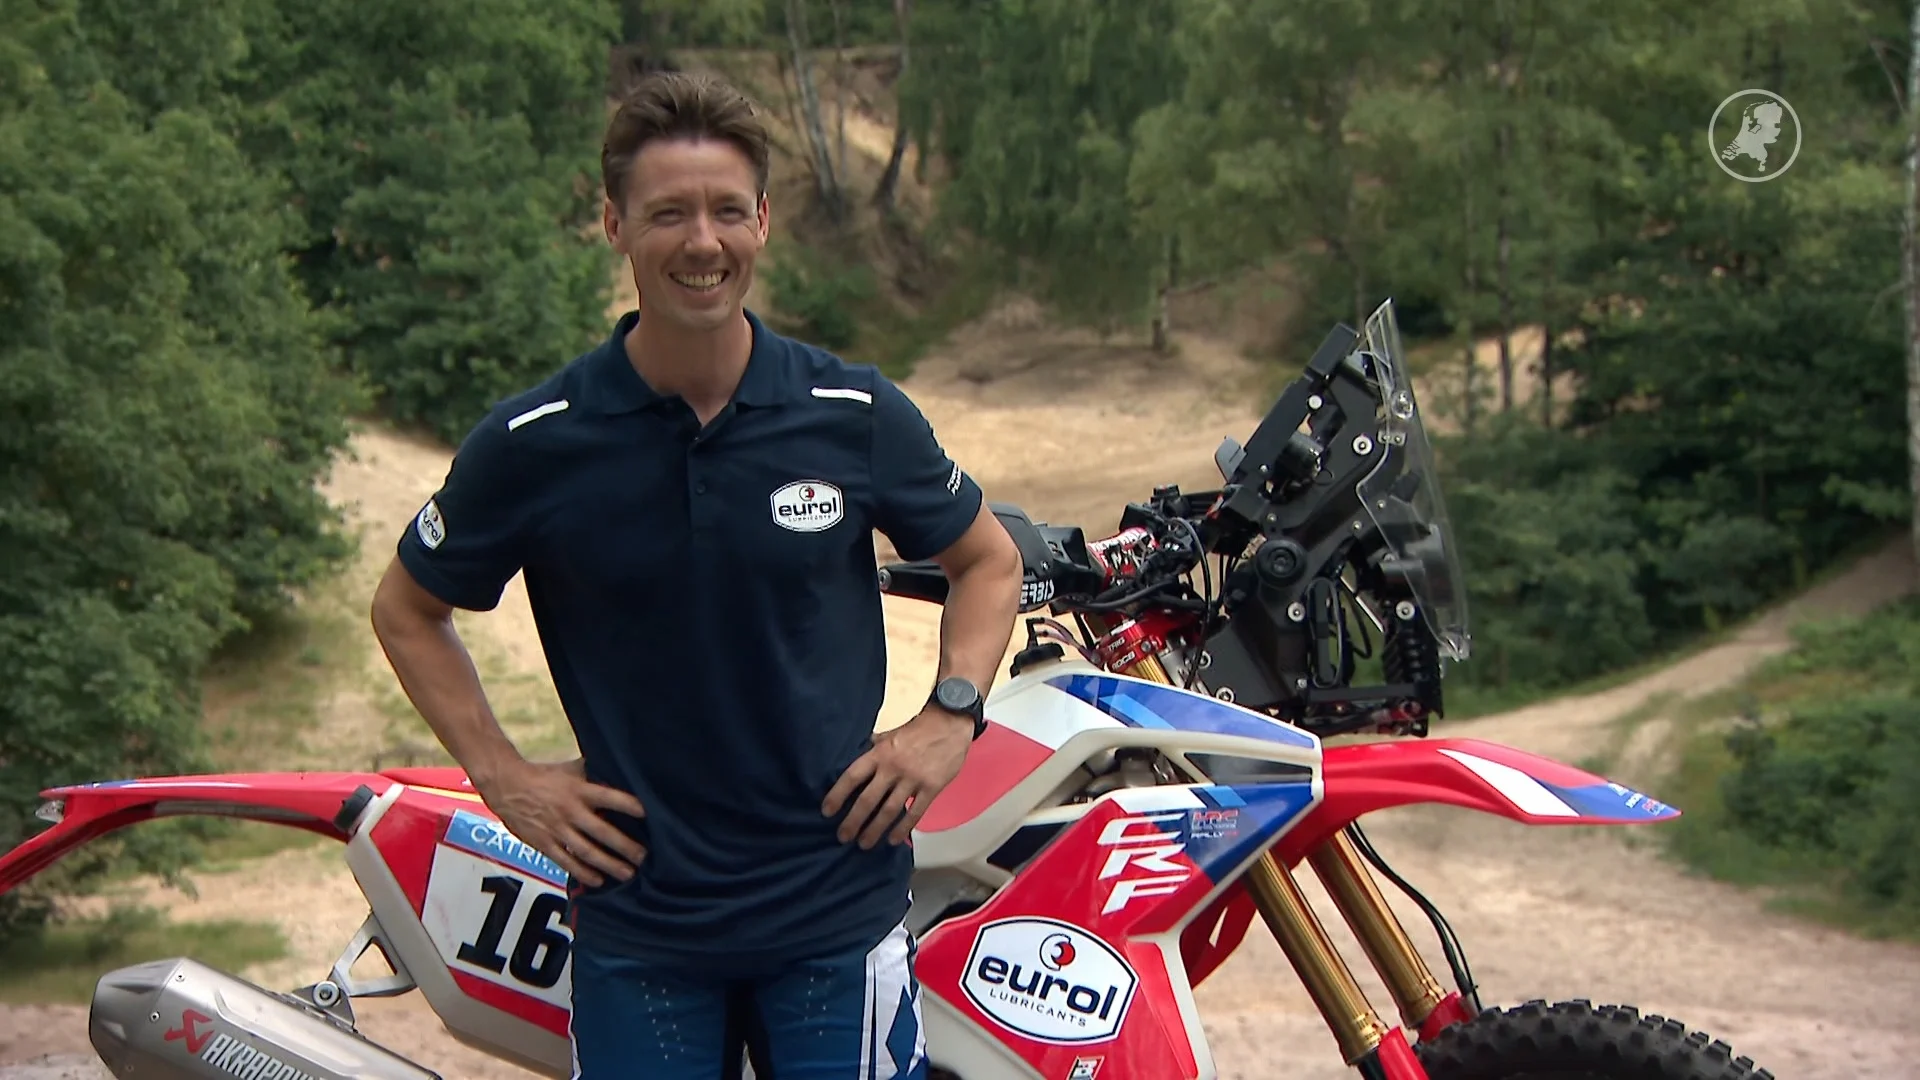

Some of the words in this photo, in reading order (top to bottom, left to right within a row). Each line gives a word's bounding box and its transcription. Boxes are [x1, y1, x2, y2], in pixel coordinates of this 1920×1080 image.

[778, 497, 837, 516] eurol
[1019, 579, 1055, 605] ERBIS
[1096, 812, 1192, 916] CRF
[456, 876, 571, 989] 16
[977, 955, 1118, 1021] eurol
[989, 987, 1087, 1028] LUBRICANTS
